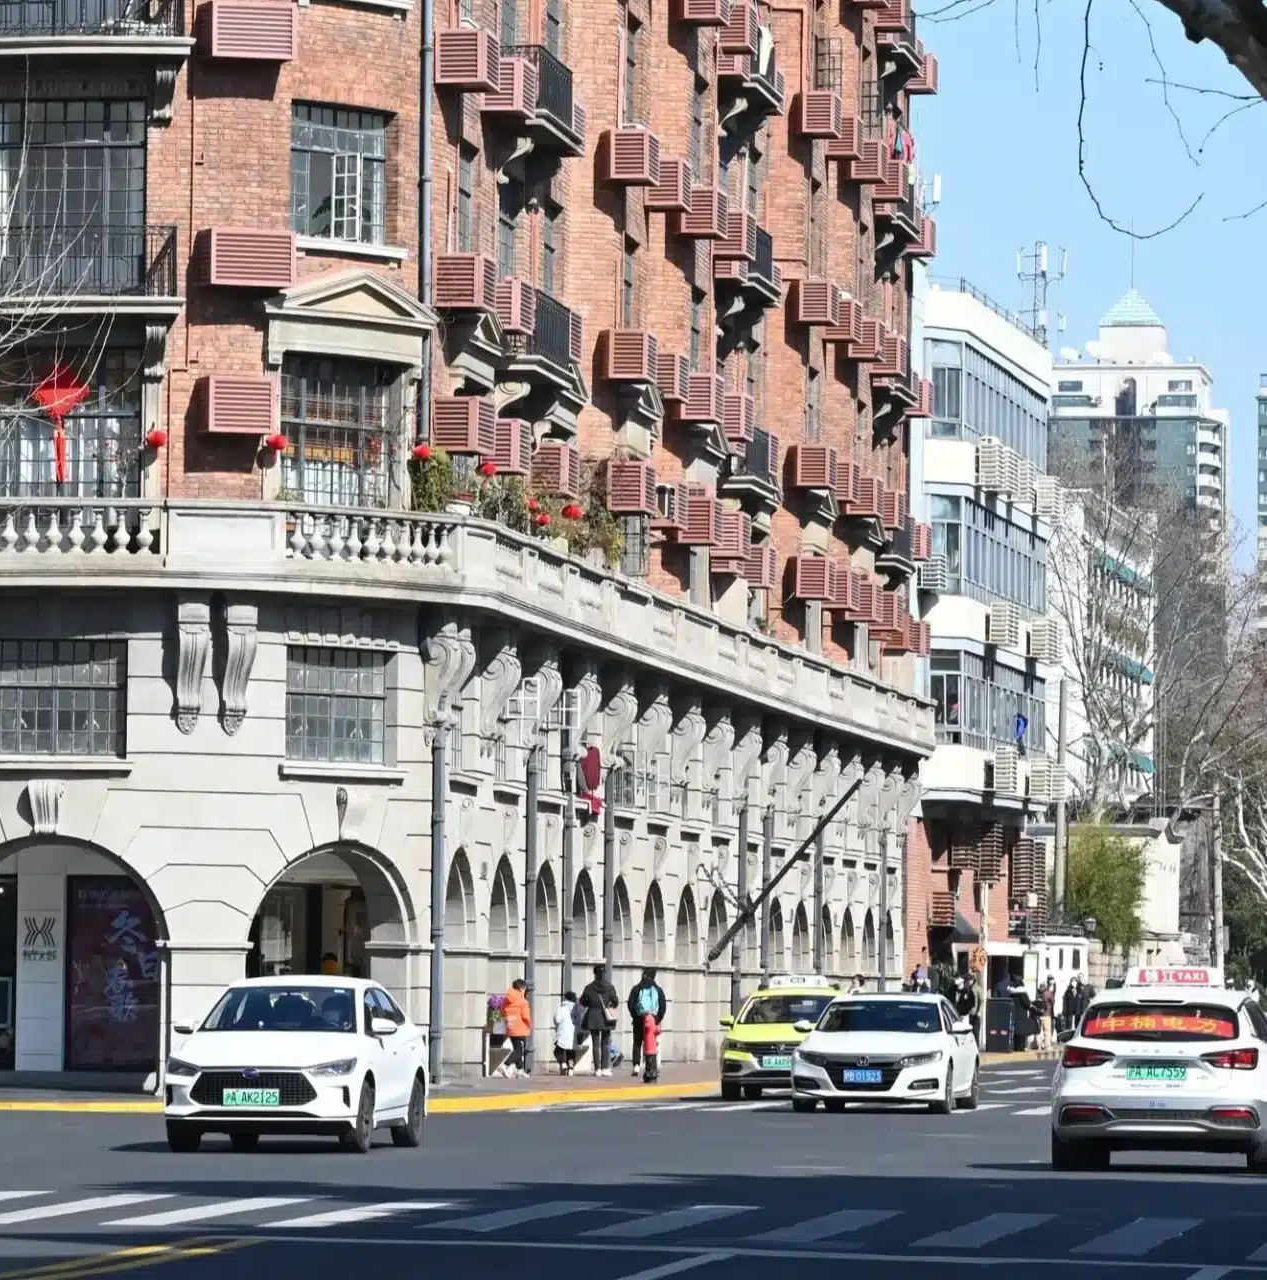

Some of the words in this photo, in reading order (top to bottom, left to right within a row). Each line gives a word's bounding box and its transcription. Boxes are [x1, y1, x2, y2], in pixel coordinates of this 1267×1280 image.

[1177, 971, 1205, 981] TAXI
[1147, 1064, 1186, 1079] AC7559
[241, 1091, 278, 1104] AK2125
